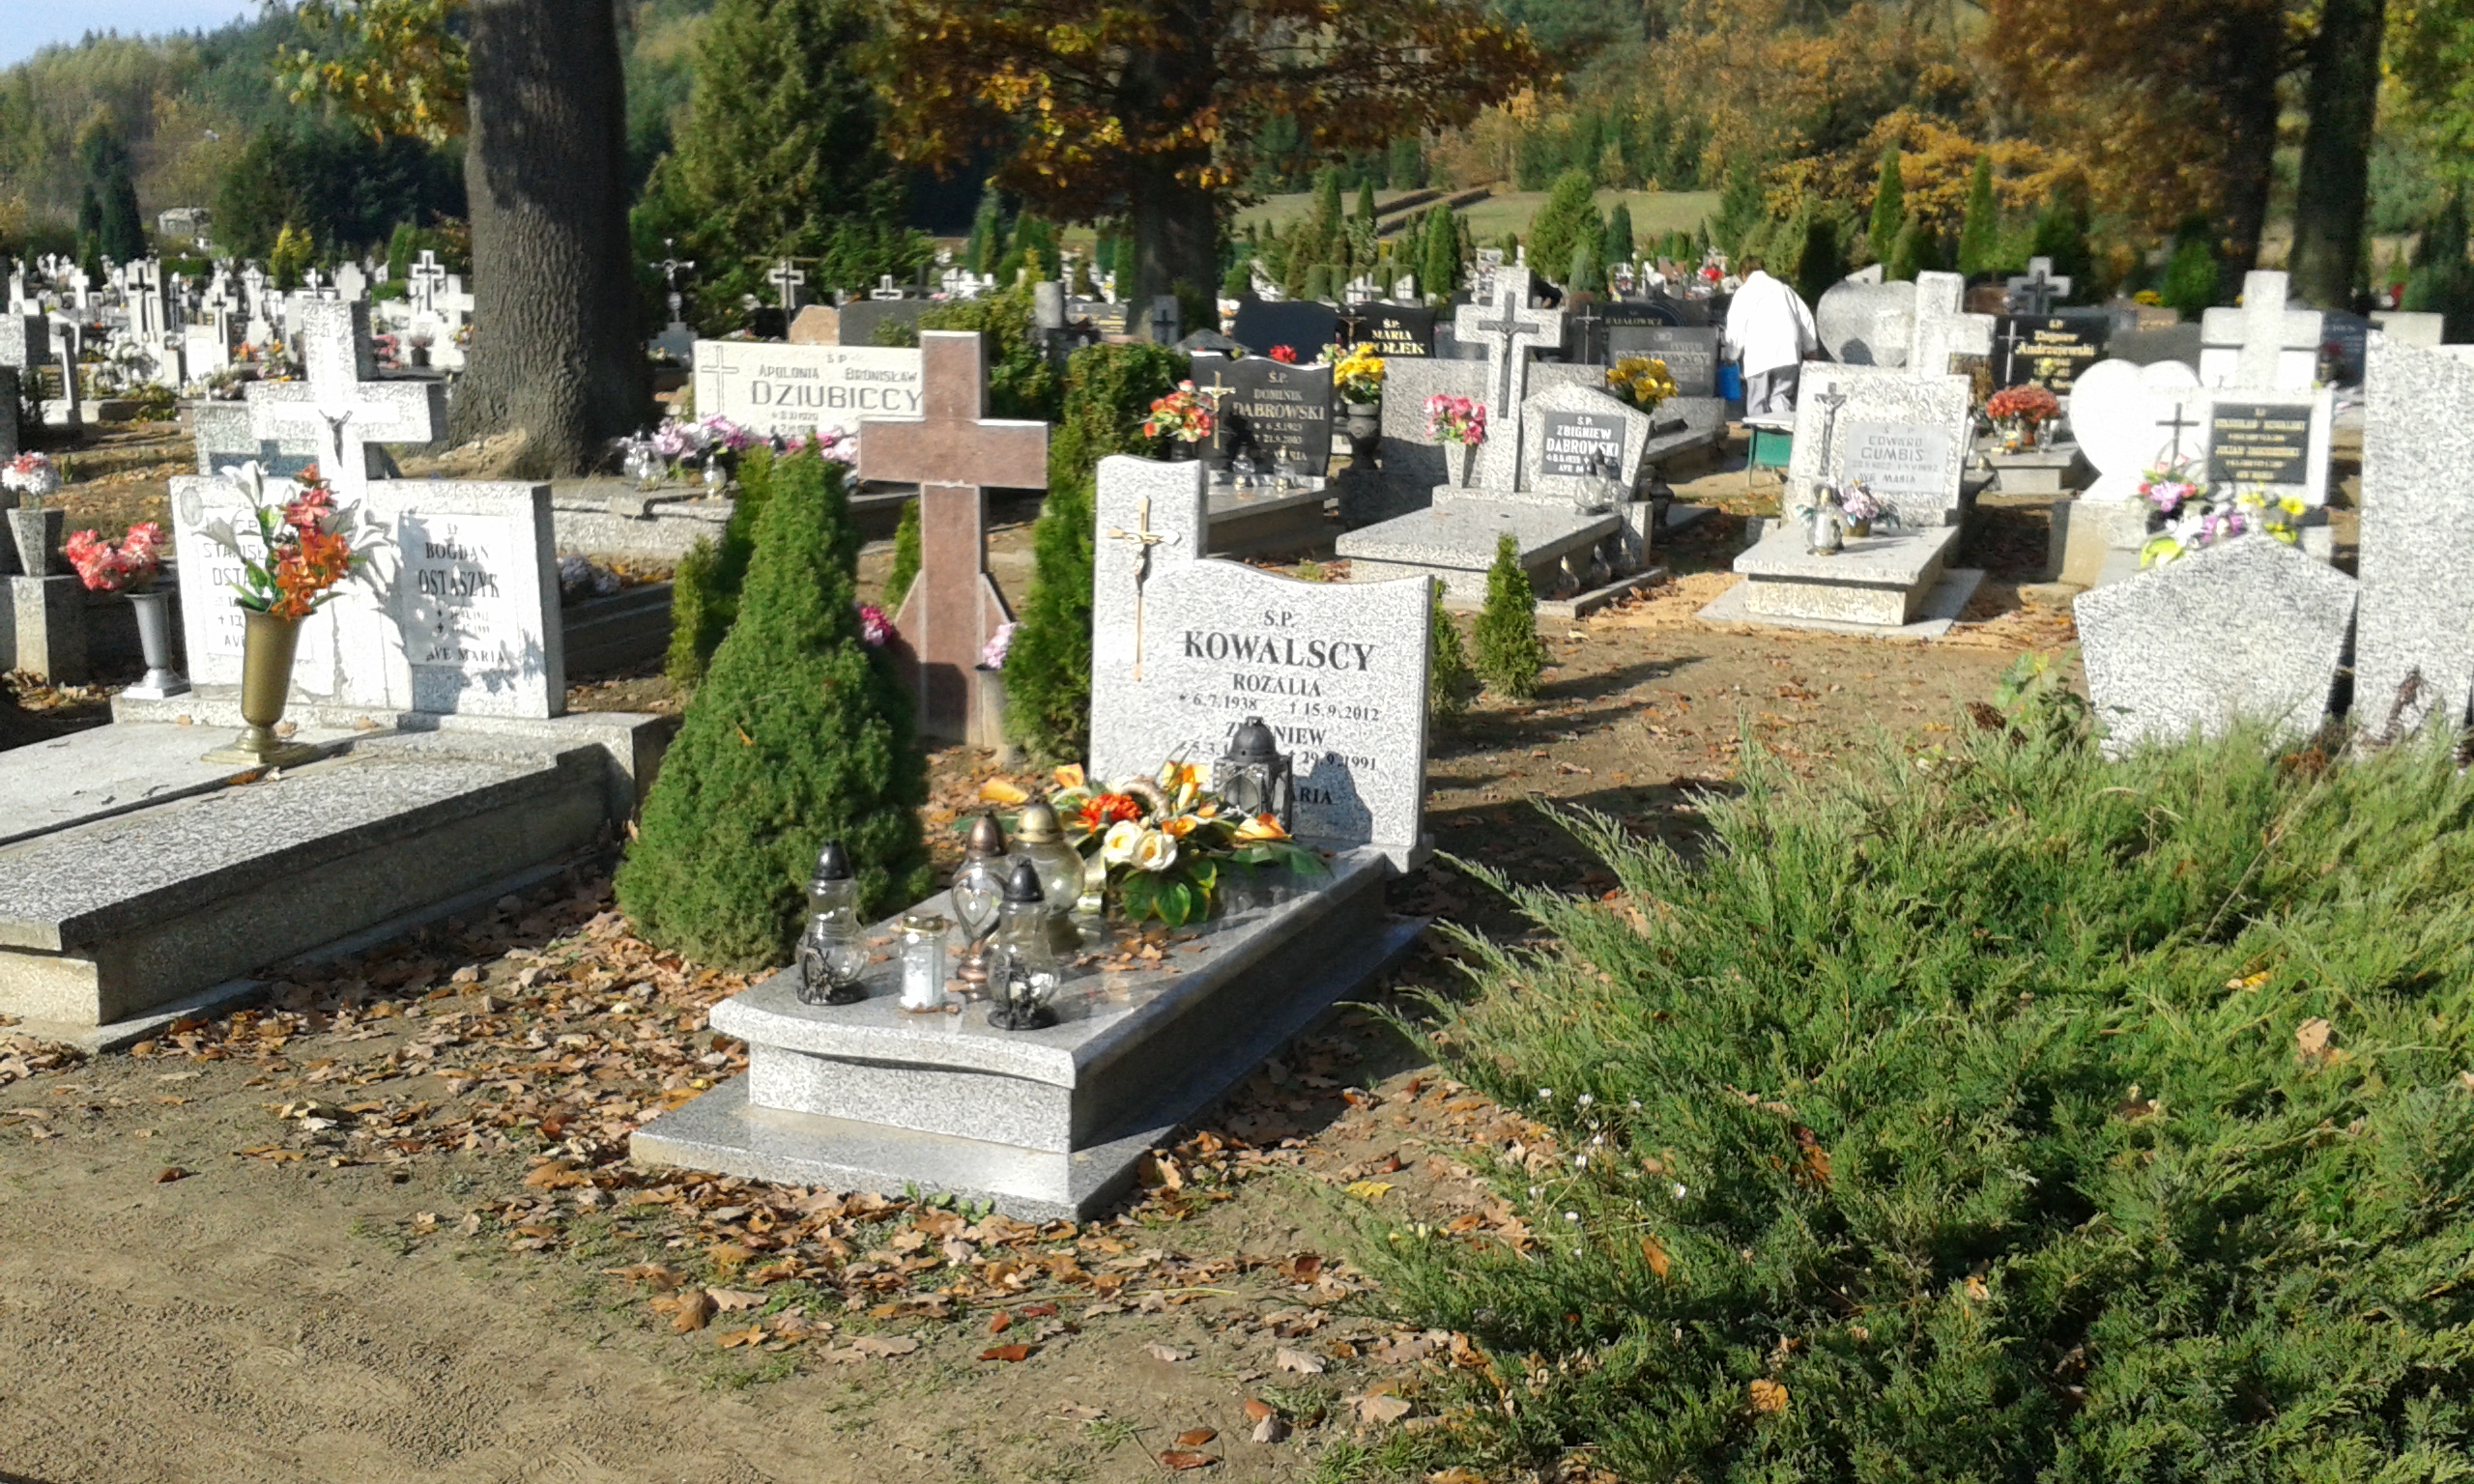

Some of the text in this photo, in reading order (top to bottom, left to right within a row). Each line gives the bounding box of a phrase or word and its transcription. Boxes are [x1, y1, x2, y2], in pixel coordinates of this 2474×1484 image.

[1372, 329, 1413, 341] MARIA
[759, 364, 820, 380] APOLONIA
[845, 367, 918, 383] BRONISŁAW
[752, 380, 923, 412] DZIUBICCY
[1253, 388, 1304, 402] DOMINIK
[1557, 425, 1612, 440] ZBIGNIEW
[1868, 436, 1923, 448] EDWARD
[1860, 446, 1924, 462] GUMBIS
[1884, 473, 1916, 484] MARIA
[425, 542, 490, 560] BOGDAN
[418, 568, 501, 598] OSTASZYK
[425, 647, 505, 664] AVE MARIA
[1184, 630, 1376, 671] KOWALSCY
[1233, 672, 1322, 698] ROZALIA
[1305, 700, 1380, 722] 15.9.2012
